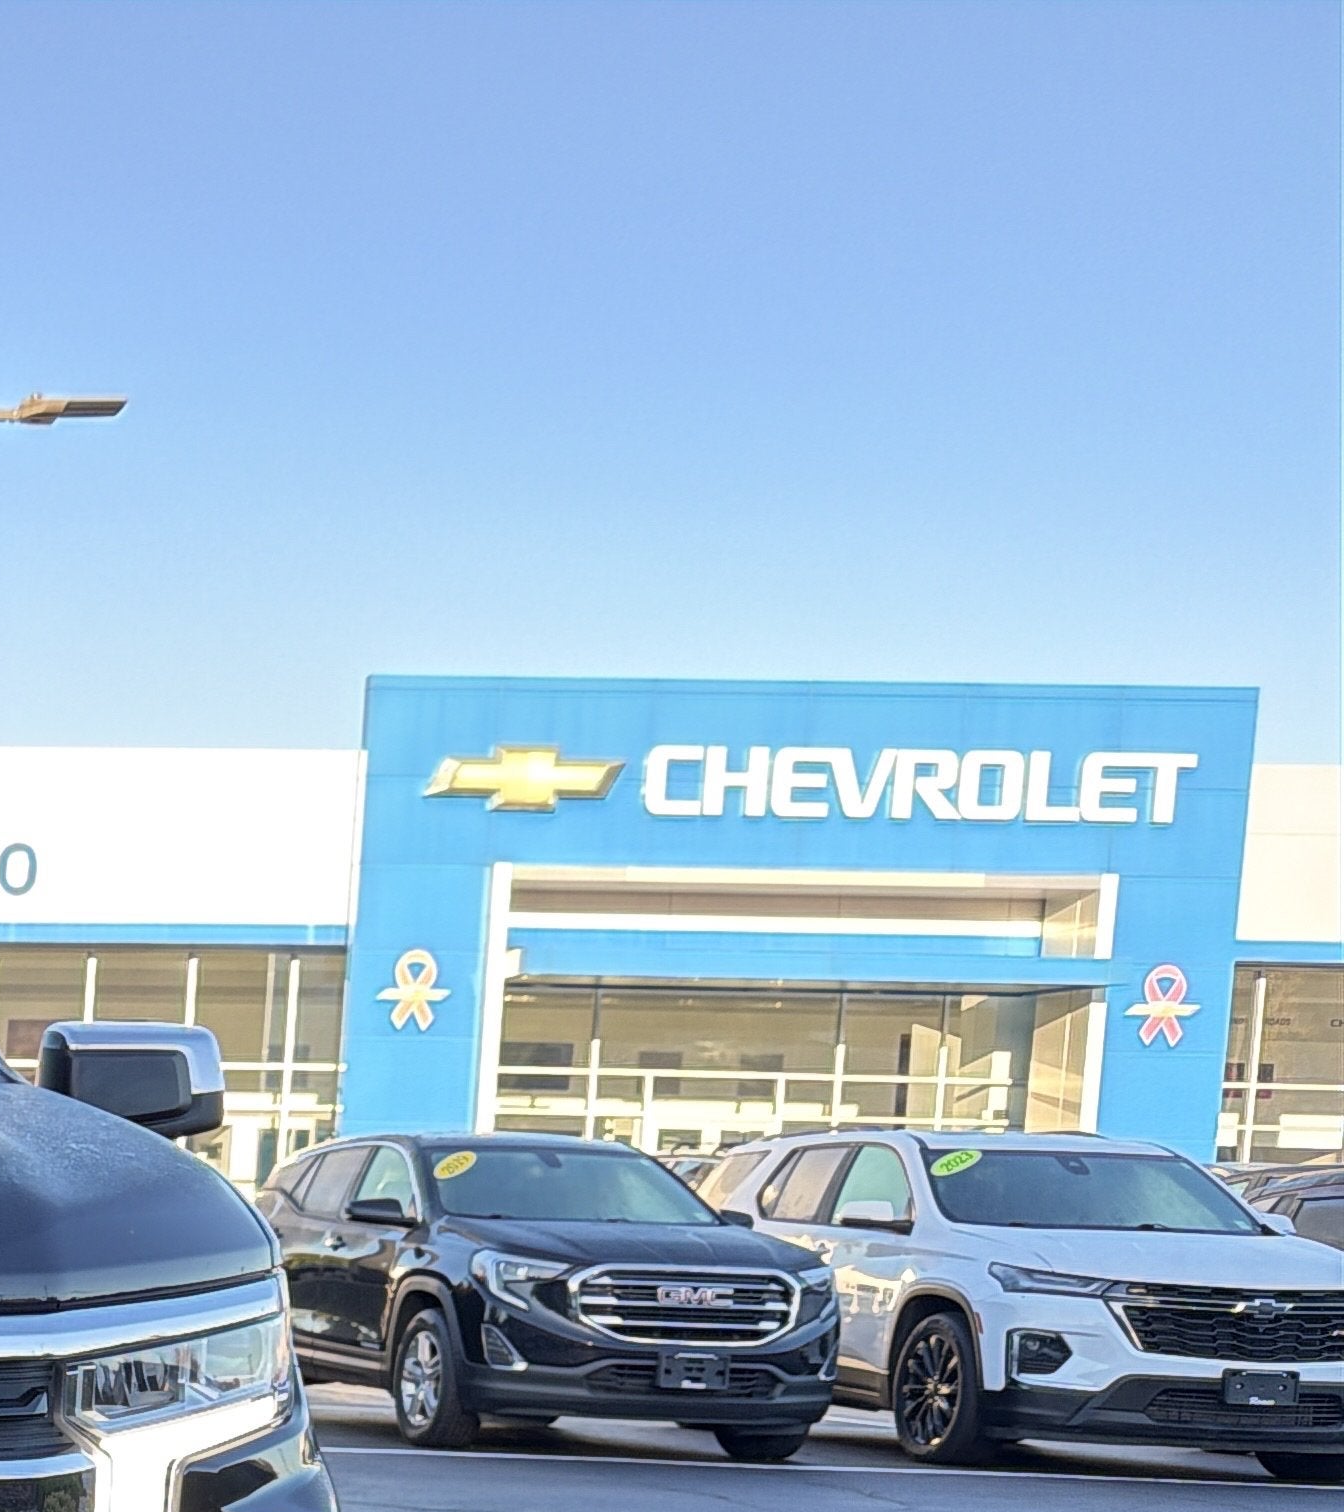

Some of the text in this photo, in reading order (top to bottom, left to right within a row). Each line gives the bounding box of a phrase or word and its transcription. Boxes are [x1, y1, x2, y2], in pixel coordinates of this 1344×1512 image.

[644, 744, 1199, 824] CHEVROLET
[940, 1151, 974, 1172] 2023
[656, 1286, 735, 1308] GMC
